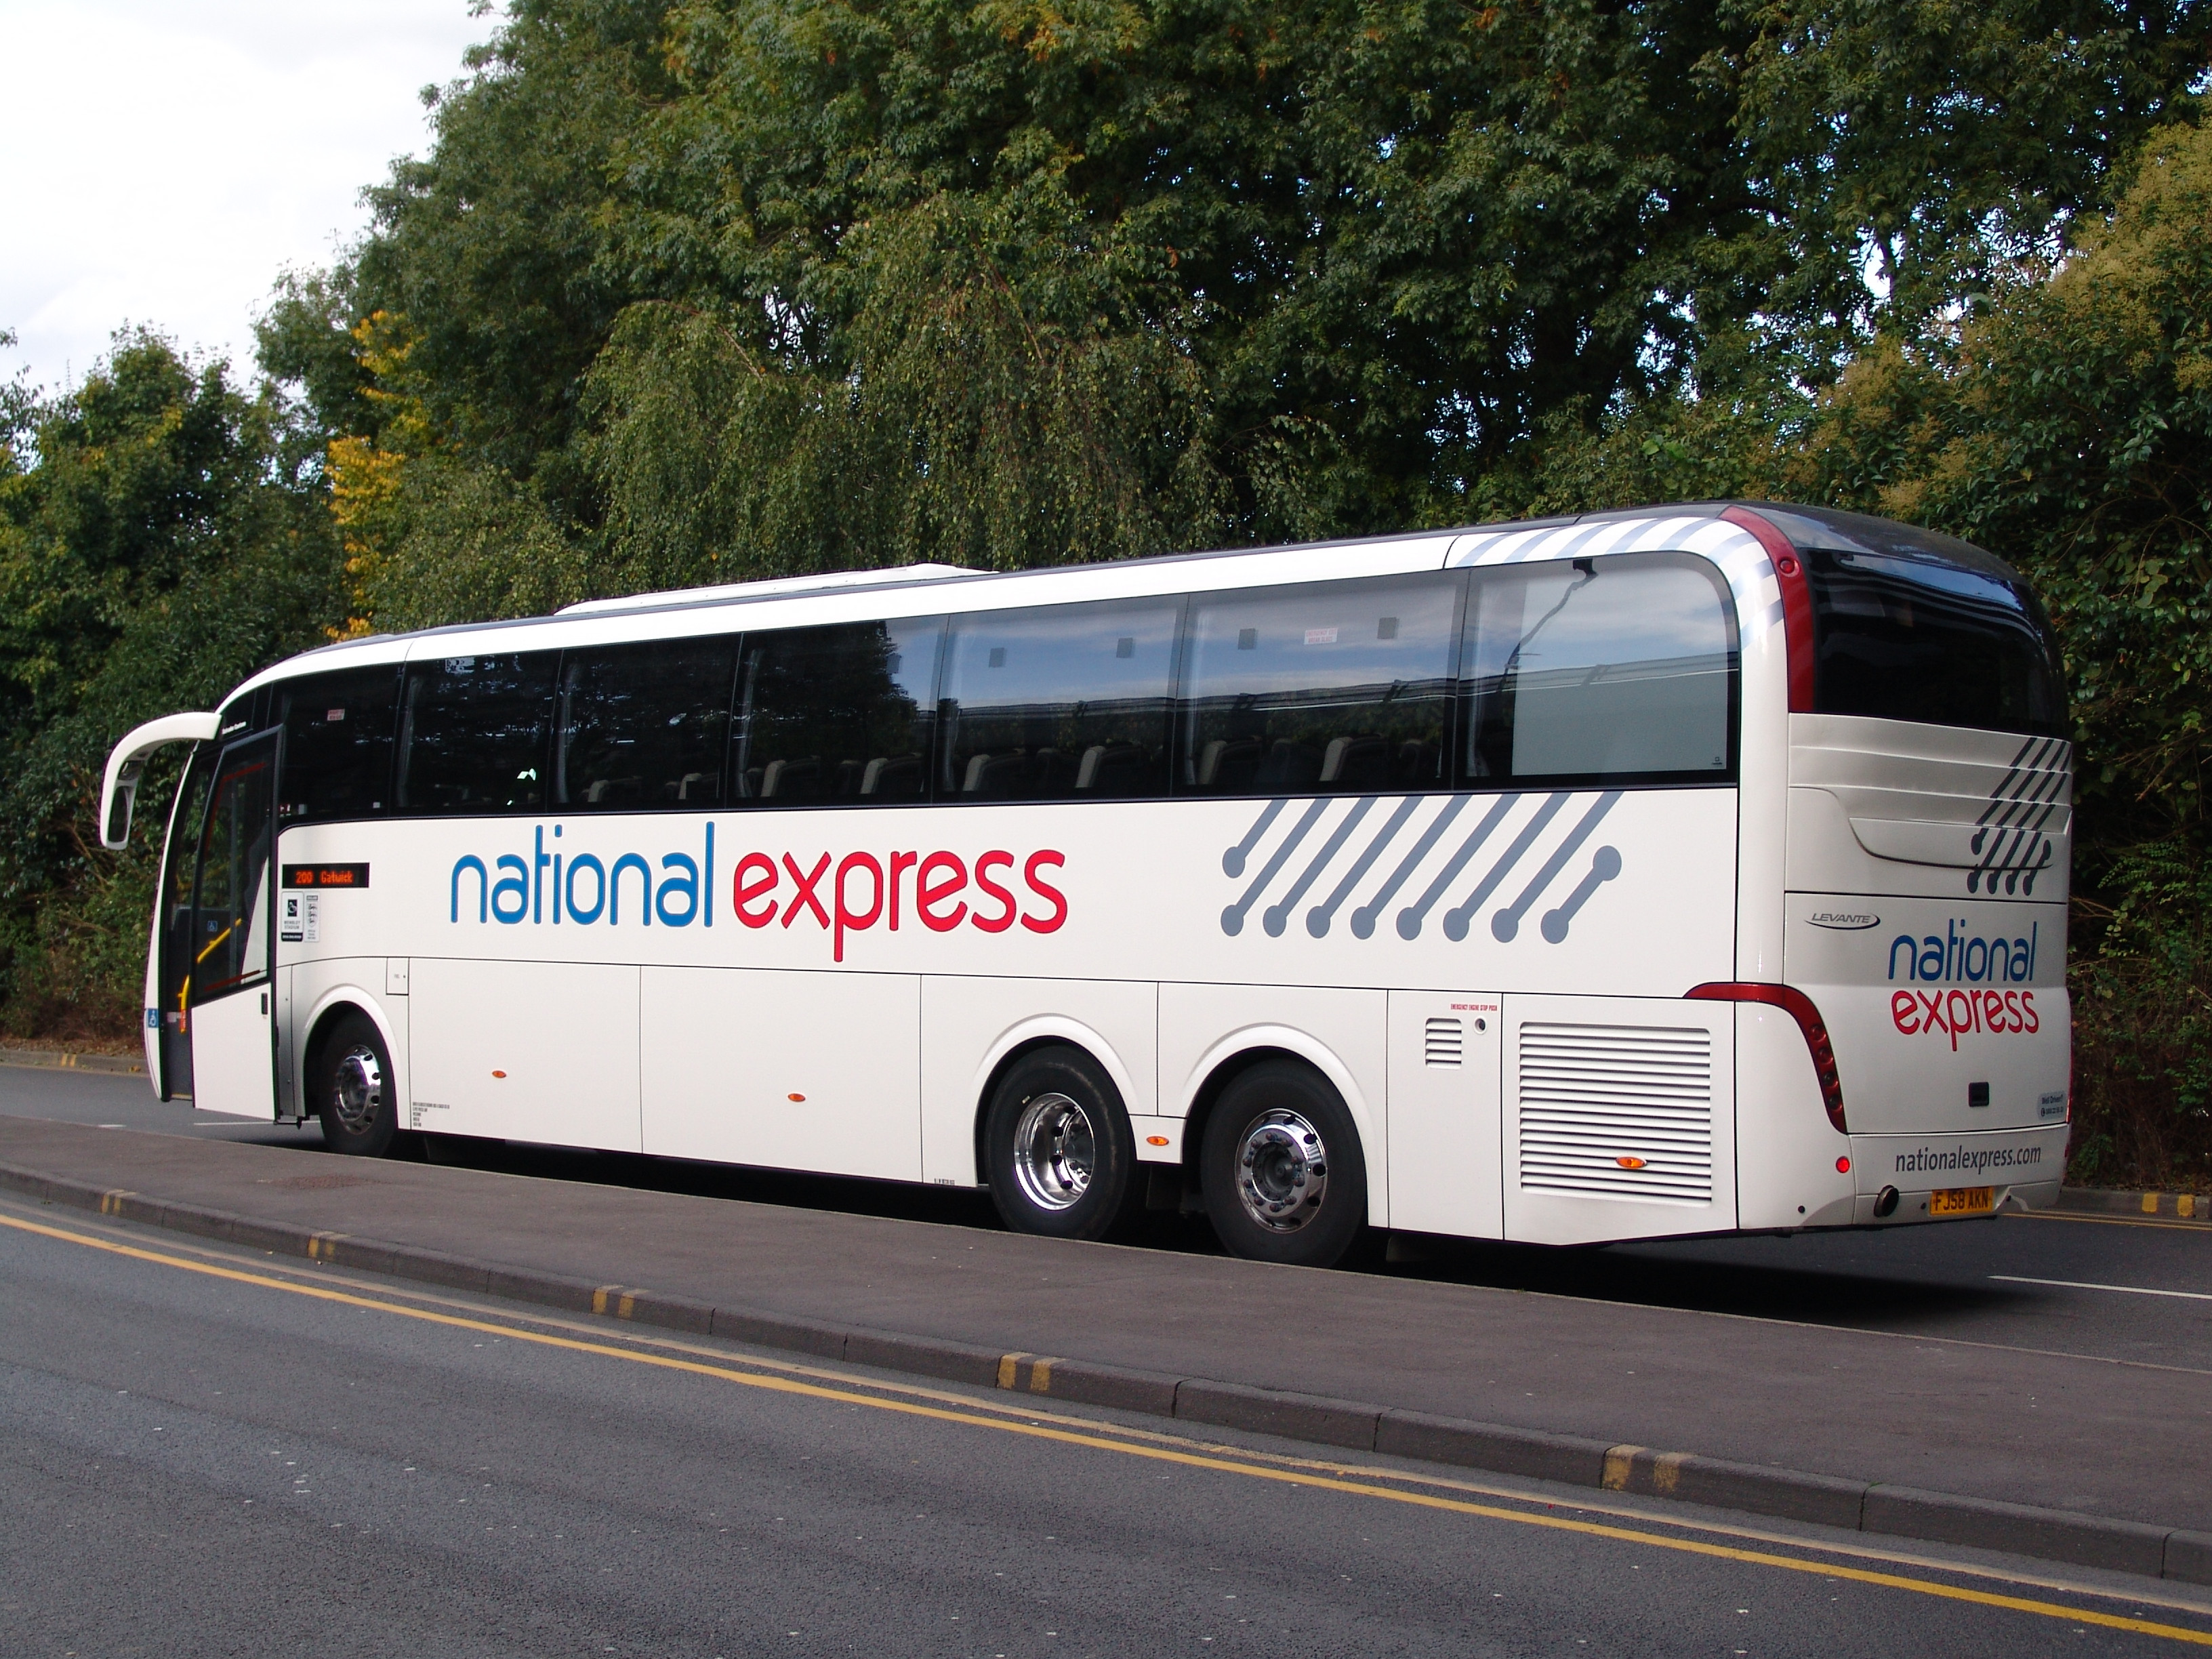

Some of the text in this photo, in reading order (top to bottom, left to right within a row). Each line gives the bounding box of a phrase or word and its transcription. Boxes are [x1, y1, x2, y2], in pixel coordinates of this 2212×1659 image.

[295, 871, 314, 884] 200
[450, 822, 1069, 963] national express
[1811, 913, 1870, 924] LEVANTE
[1888, 918, 2037, 981] national
[1891, 989, 2039, 1052] express
[1895, 1145, 2041, 1175] nationalexpress.com
[1935, 1189, 1989, 1212] FJ58 AKN
